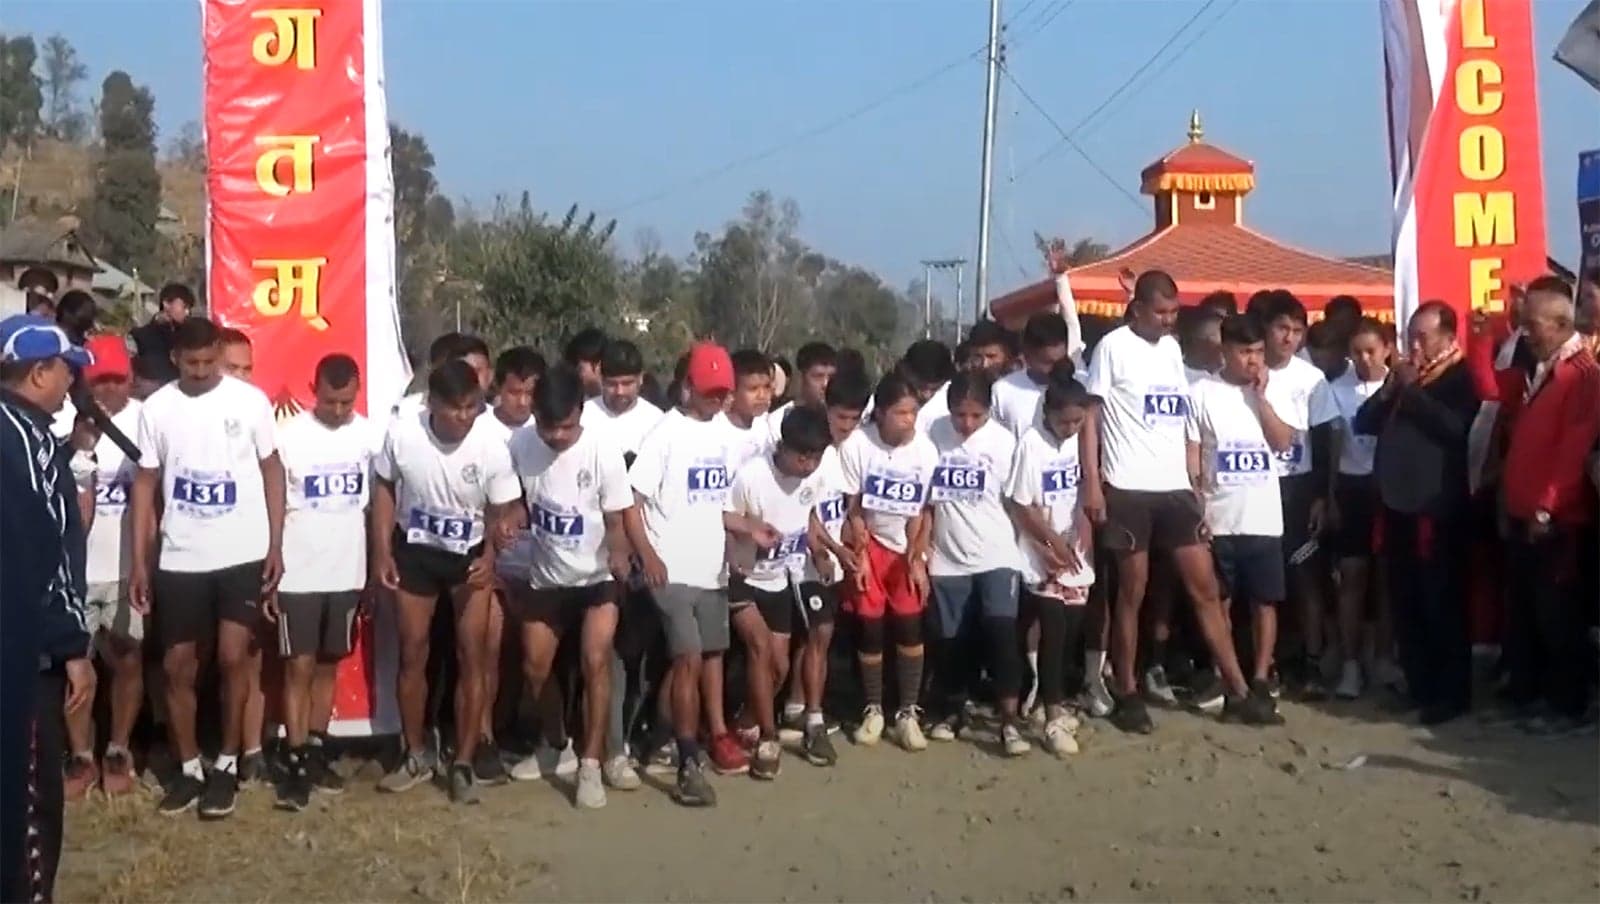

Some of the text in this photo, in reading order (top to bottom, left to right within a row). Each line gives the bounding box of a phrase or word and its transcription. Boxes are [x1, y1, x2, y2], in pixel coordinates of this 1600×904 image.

[1150, 395, 1179, 415] 147
[1225, 453, 1265, 471] 103
[313, 473, 360, 497] 105
[873, 478, 917, 501] 149
[939, 468, 979, 488] 166
[181, 480, 226, 504] 131
[419, 513, 464, 539] 113
[538, 510, 576, 534] 117
